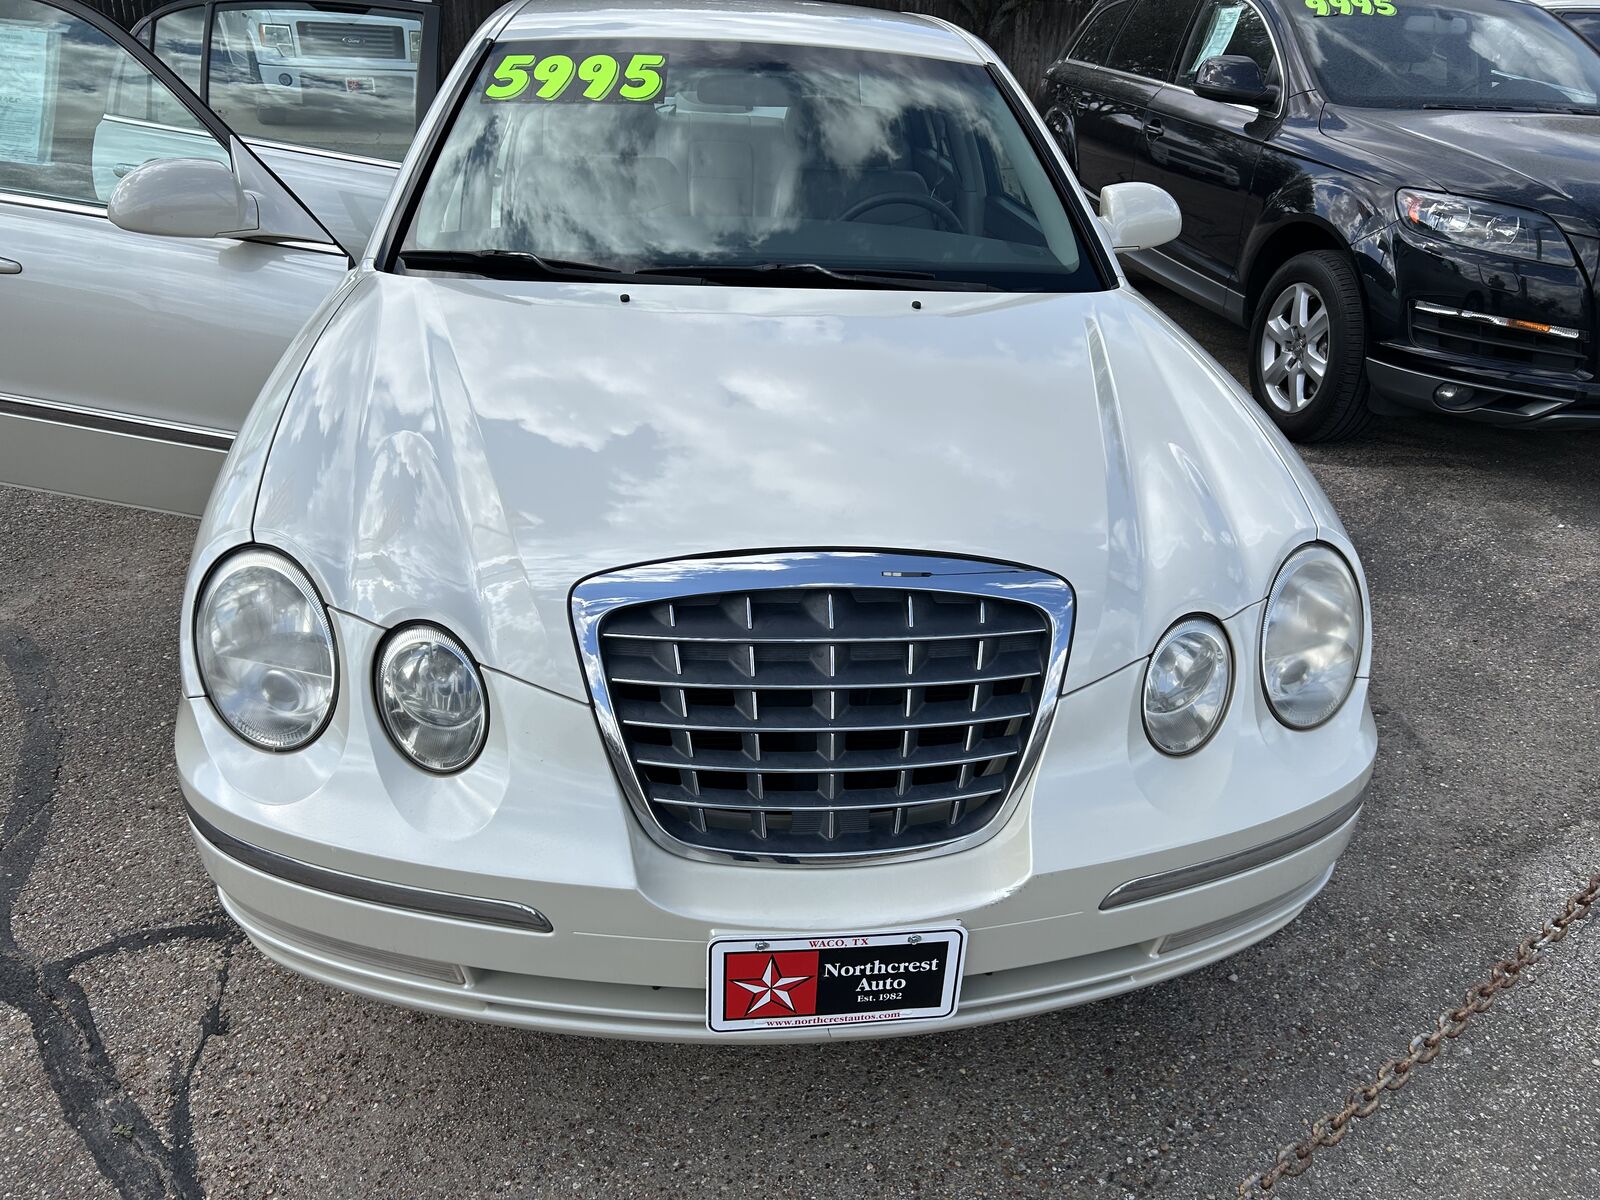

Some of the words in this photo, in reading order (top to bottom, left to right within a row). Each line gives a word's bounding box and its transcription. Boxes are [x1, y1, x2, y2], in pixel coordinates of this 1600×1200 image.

[1305, 0, 1397, 16] 9995
[485, 54, 666, 101] 5995
[809, 939, 848, 948] WACO,
[852, 938, 869, 946] TX
[824, 958, 939, 977] Northcrest
[855, 976, 907, 992] Auto
[857, 994, 876, 1003] Est.
[879, 992, 903, 1001] 1982
[766, 1012, 901, 1027] www.northcrestautos.com
